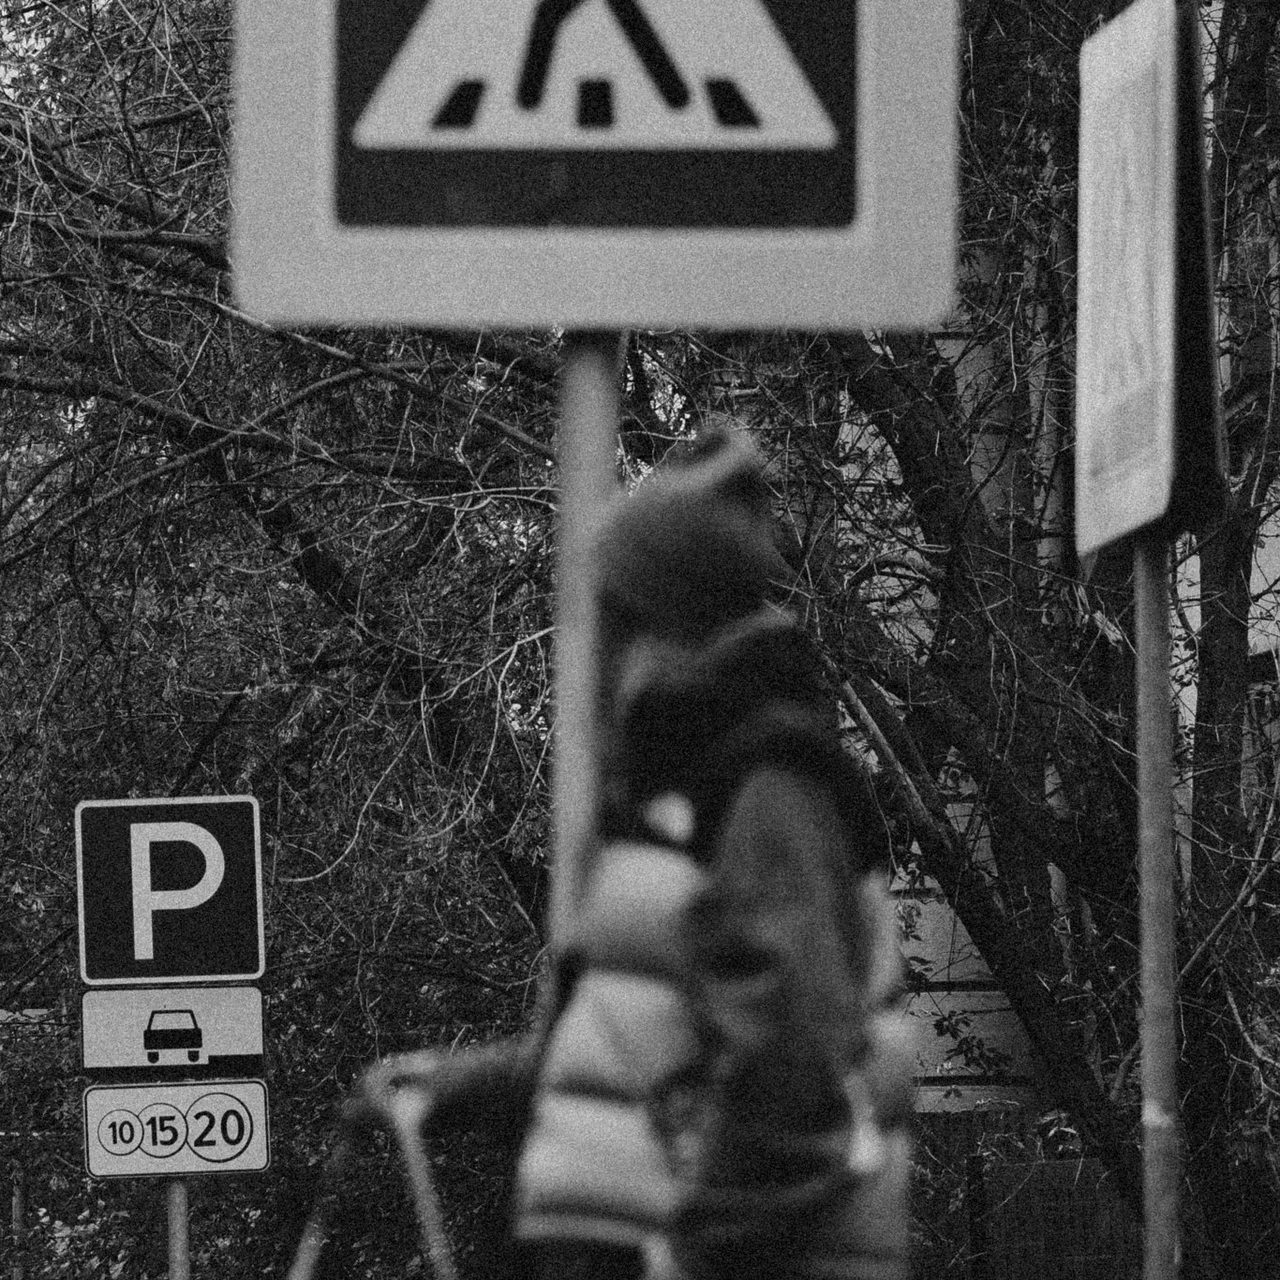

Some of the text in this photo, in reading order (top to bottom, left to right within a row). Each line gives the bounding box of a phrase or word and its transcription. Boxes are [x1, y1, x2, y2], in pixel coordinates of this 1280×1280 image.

[130, 822, 225, 960] P
[108, 1109, 245, 1147] 10 15 20
